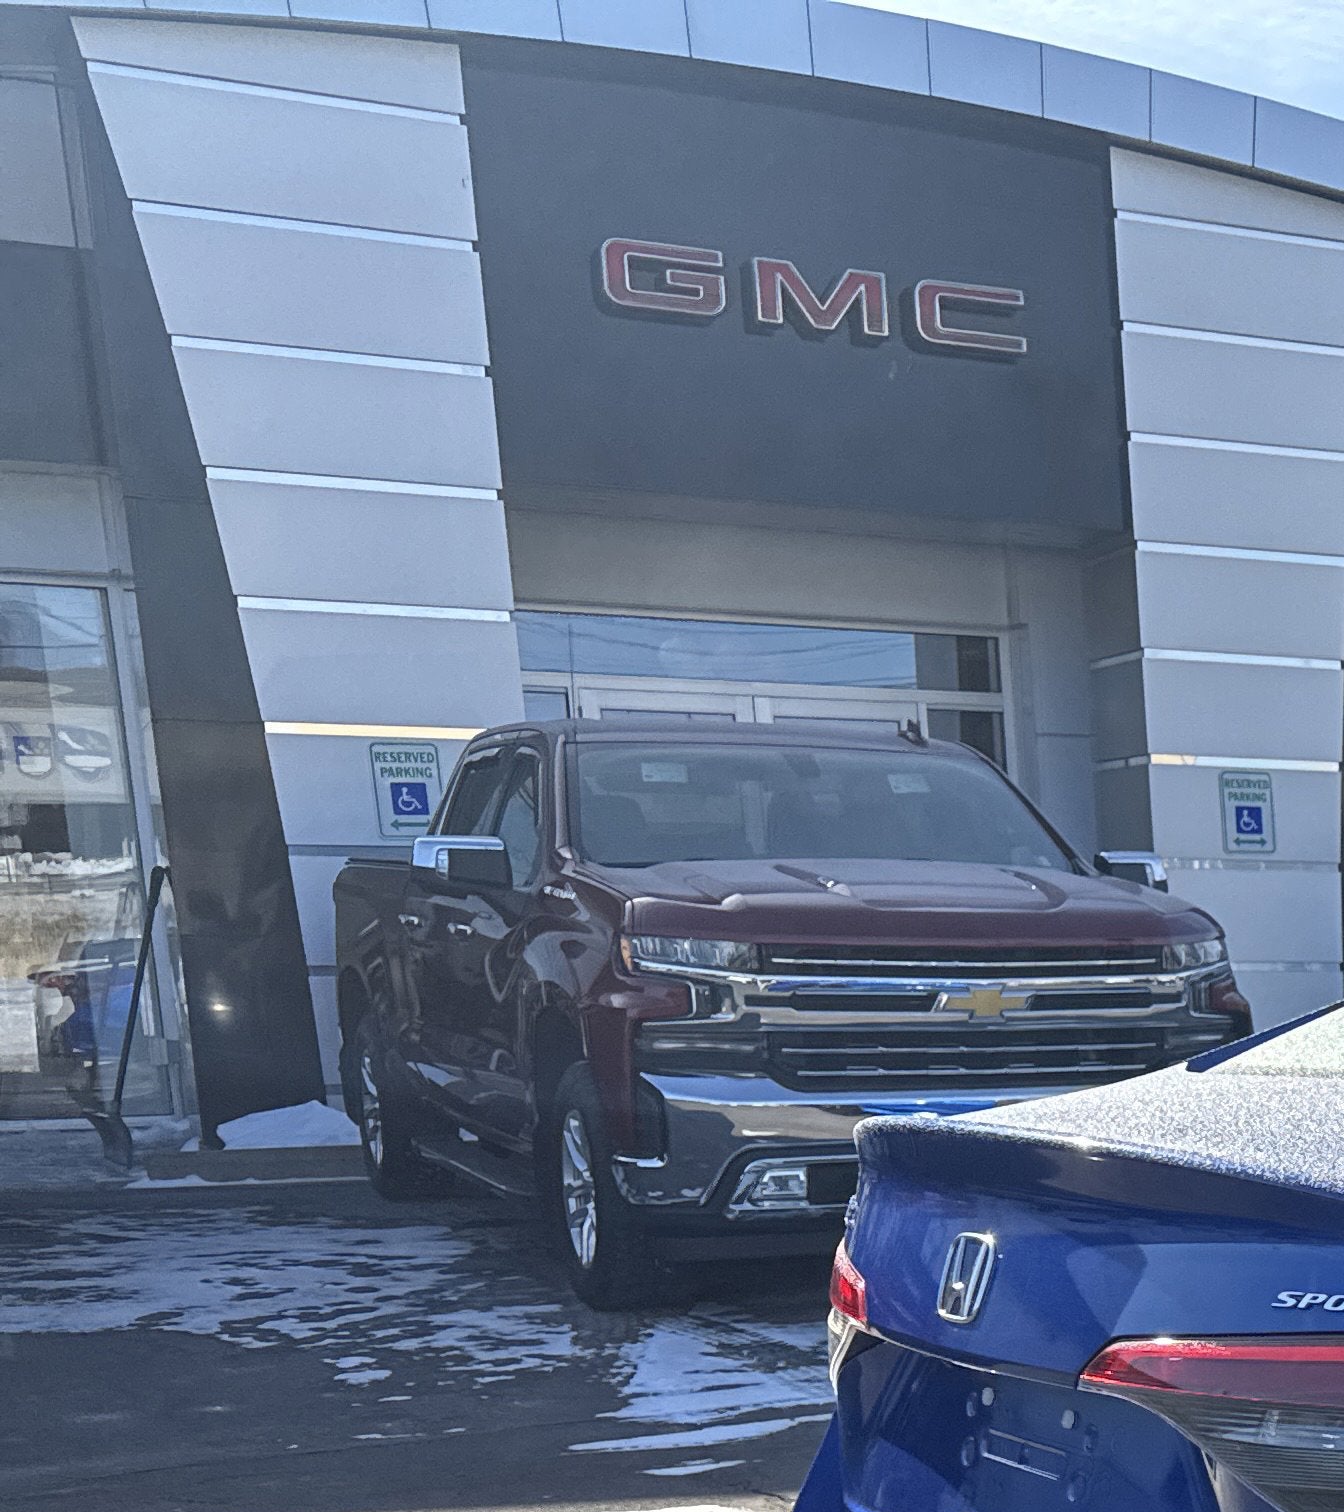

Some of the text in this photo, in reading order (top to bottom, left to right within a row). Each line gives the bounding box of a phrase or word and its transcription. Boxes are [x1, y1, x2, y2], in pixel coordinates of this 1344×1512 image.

[601, 237, 1027, 353] GMC
[374, 751, 435, 763] RESERVED
[380, 766, 433, 778] PARKING
